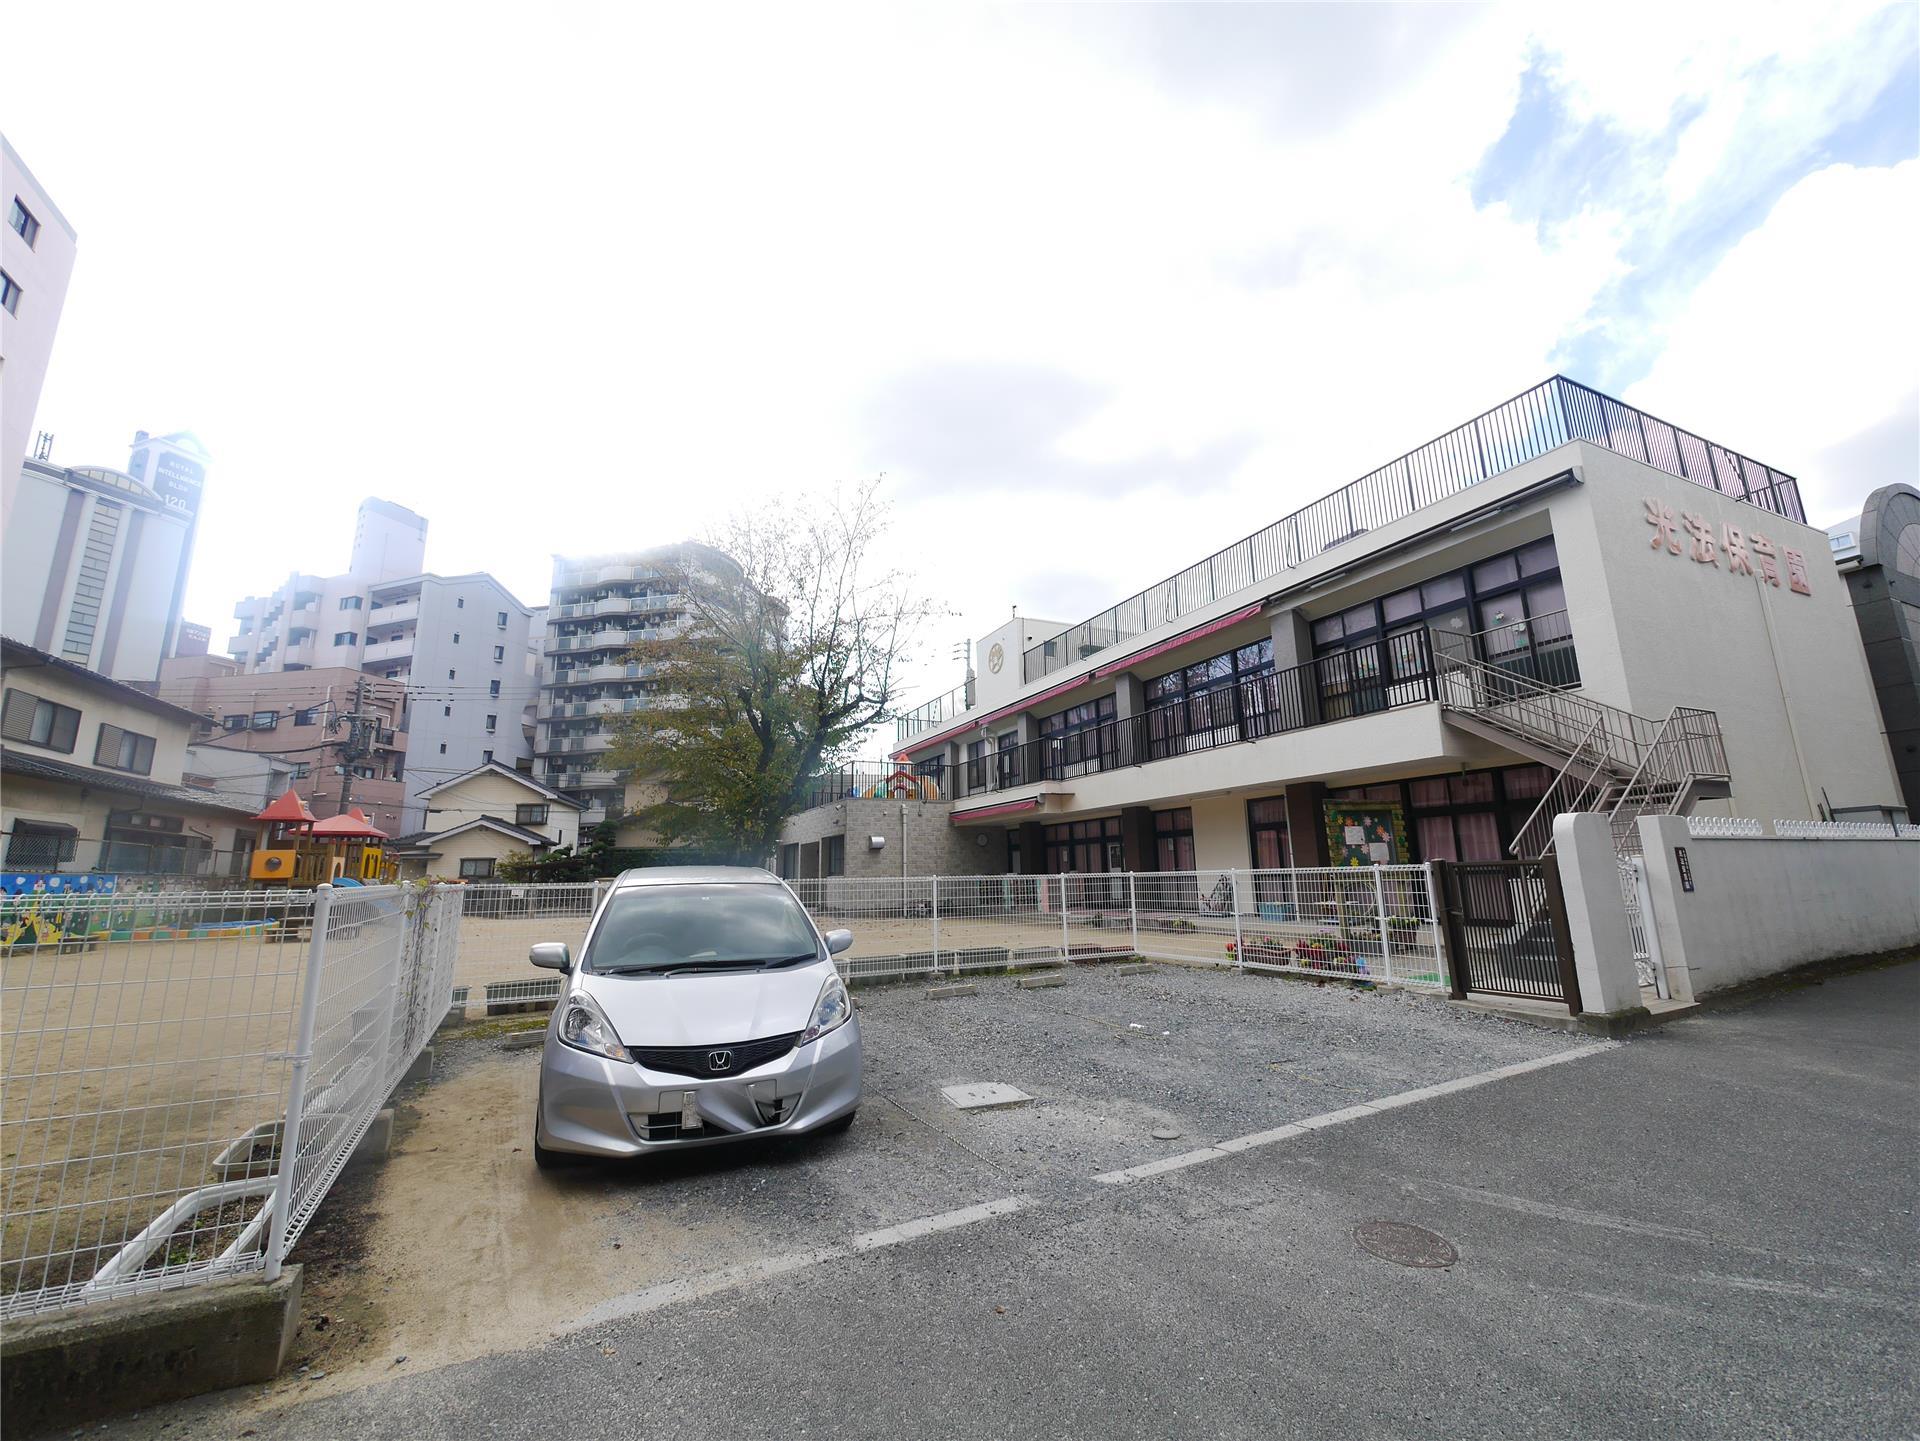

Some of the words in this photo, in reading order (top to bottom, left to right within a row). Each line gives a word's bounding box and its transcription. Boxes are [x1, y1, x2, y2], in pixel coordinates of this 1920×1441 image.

[165, 494, 186, 510] 120
[1642, 496, 1812, 597] 光法保育園
